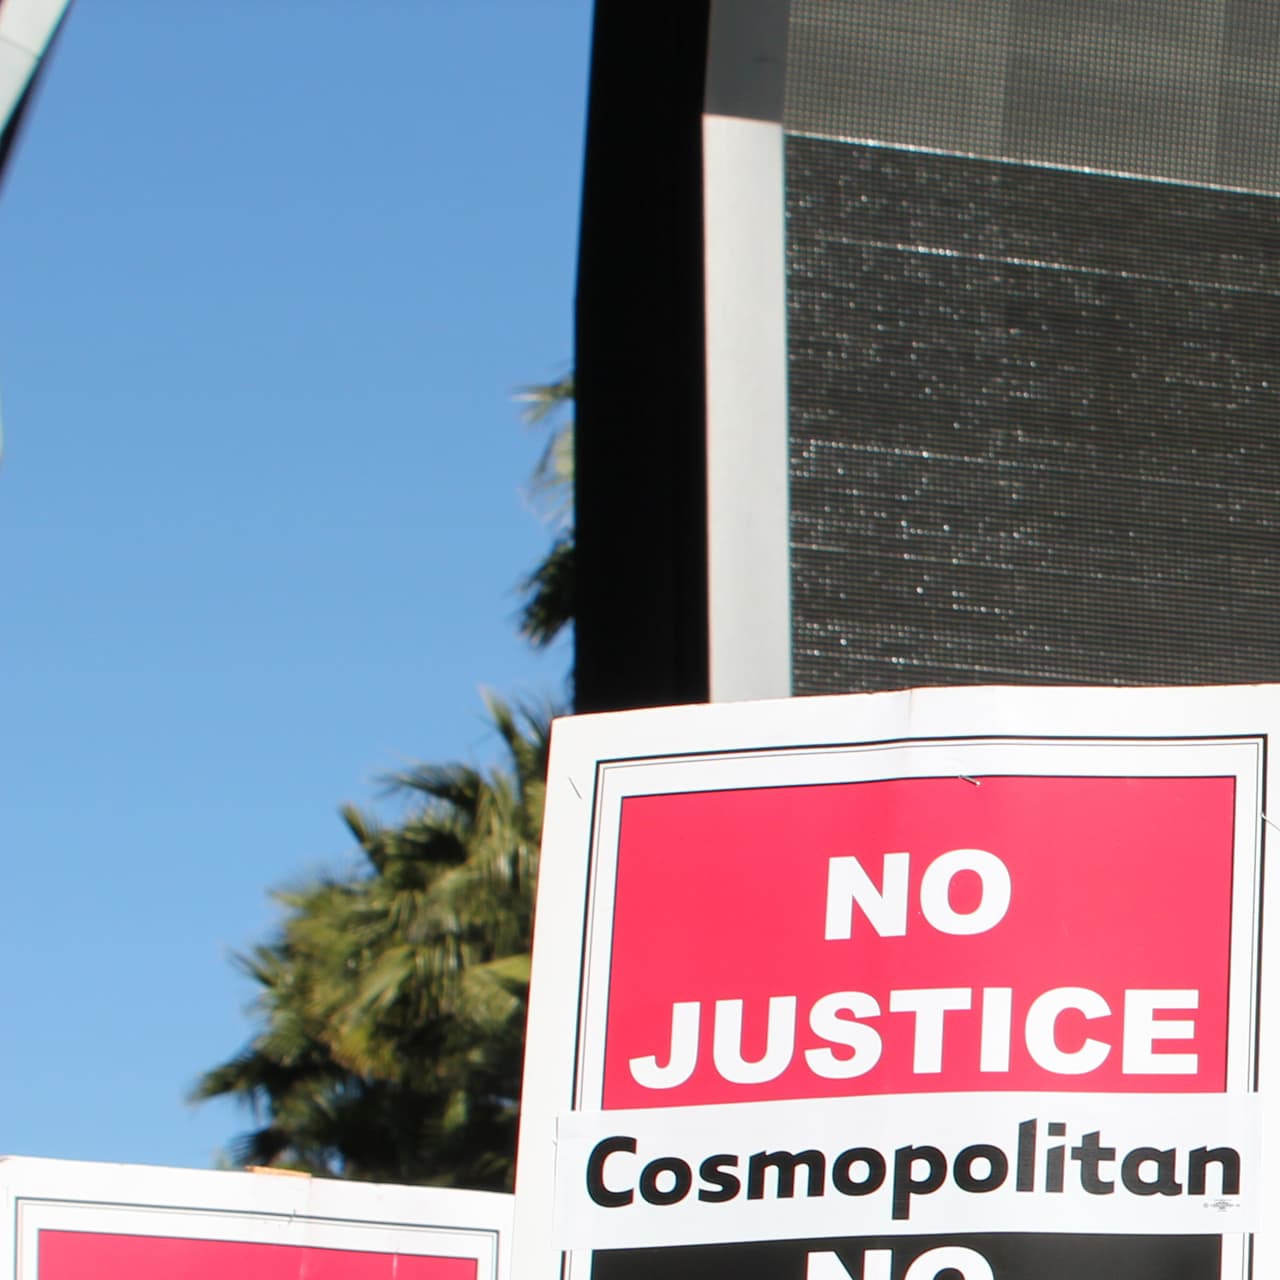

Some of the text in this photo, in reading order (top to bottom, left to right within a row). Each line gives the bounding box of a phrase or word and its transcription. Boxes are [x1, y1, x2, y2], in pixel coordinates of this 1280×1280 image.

[824, 848, 1012, 940] NO
[629, 986, 1199, 1089] JUSTICE
[586, 1118, 1241, 1220] Cosmopolitan
